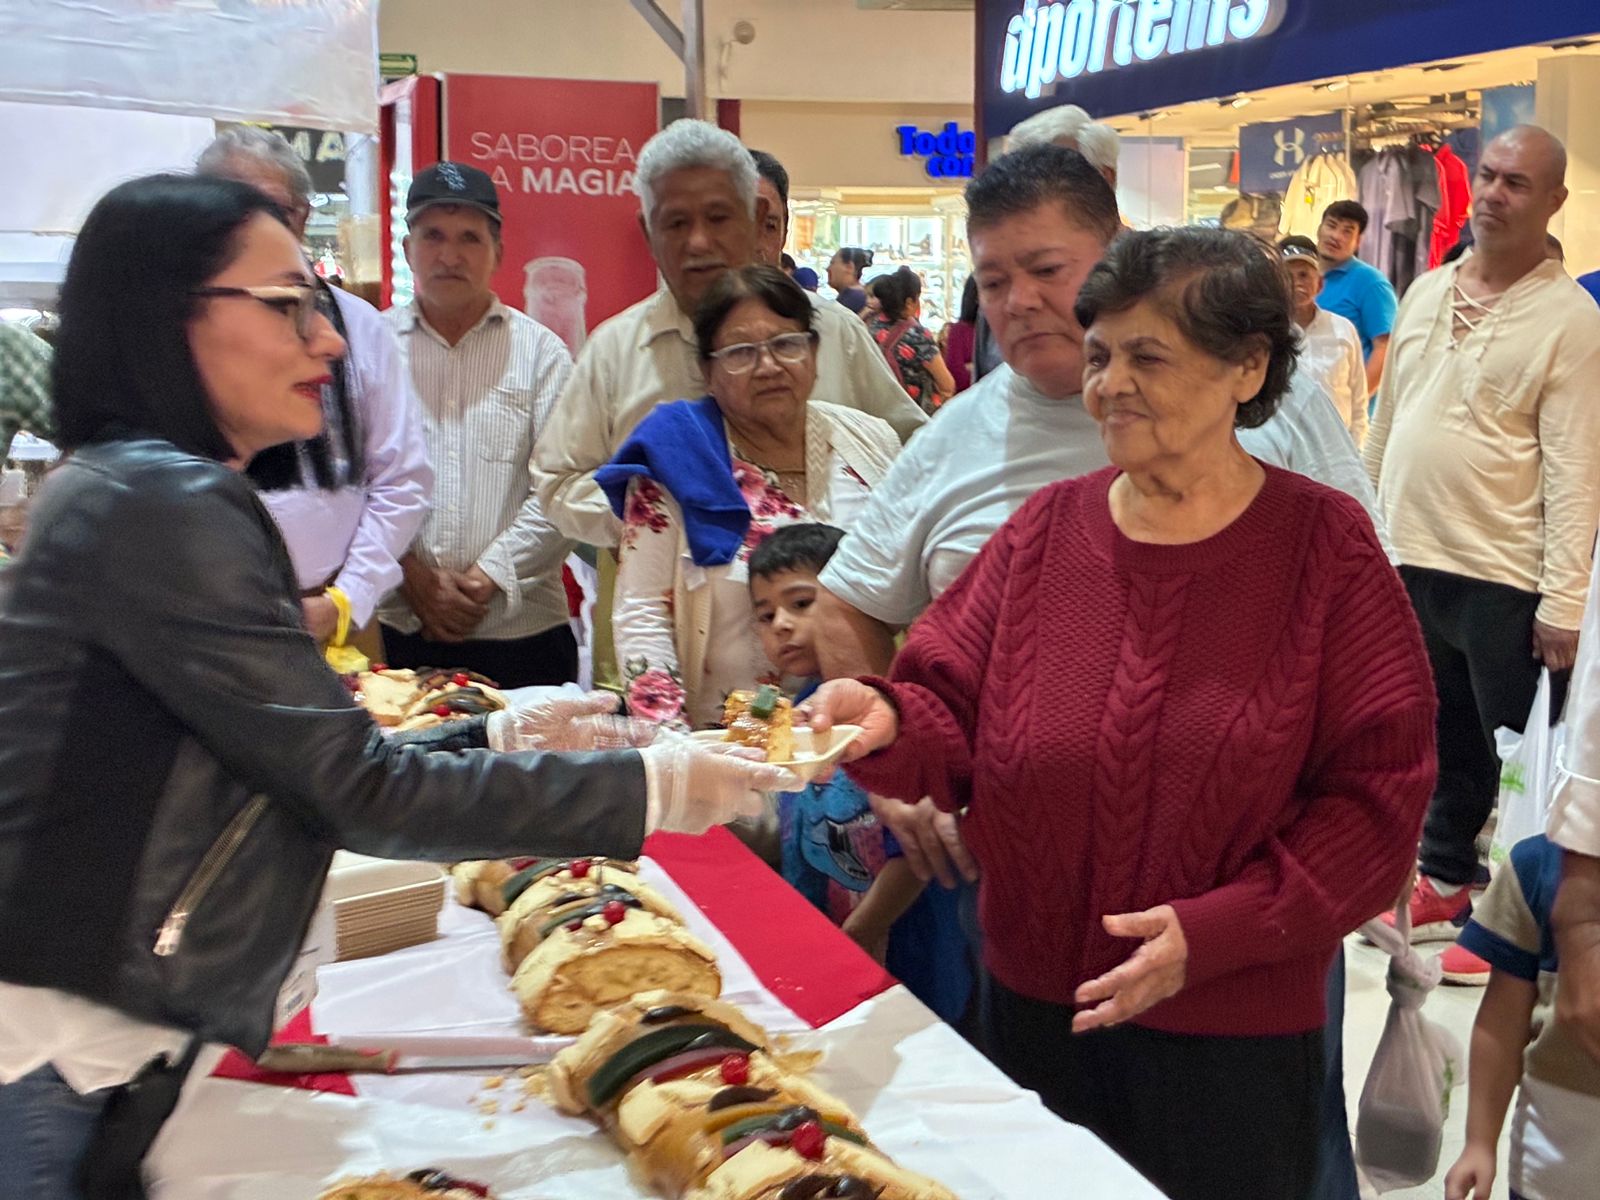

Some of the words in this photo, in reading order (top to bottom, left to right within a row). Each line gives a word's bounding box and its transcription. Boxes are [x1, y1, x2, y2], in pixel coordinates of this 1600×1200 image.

[471, 131, 638, 164] SABOREA
[491, 165, 513, 193] A
[522, 166, 634, 196] MAGIA
